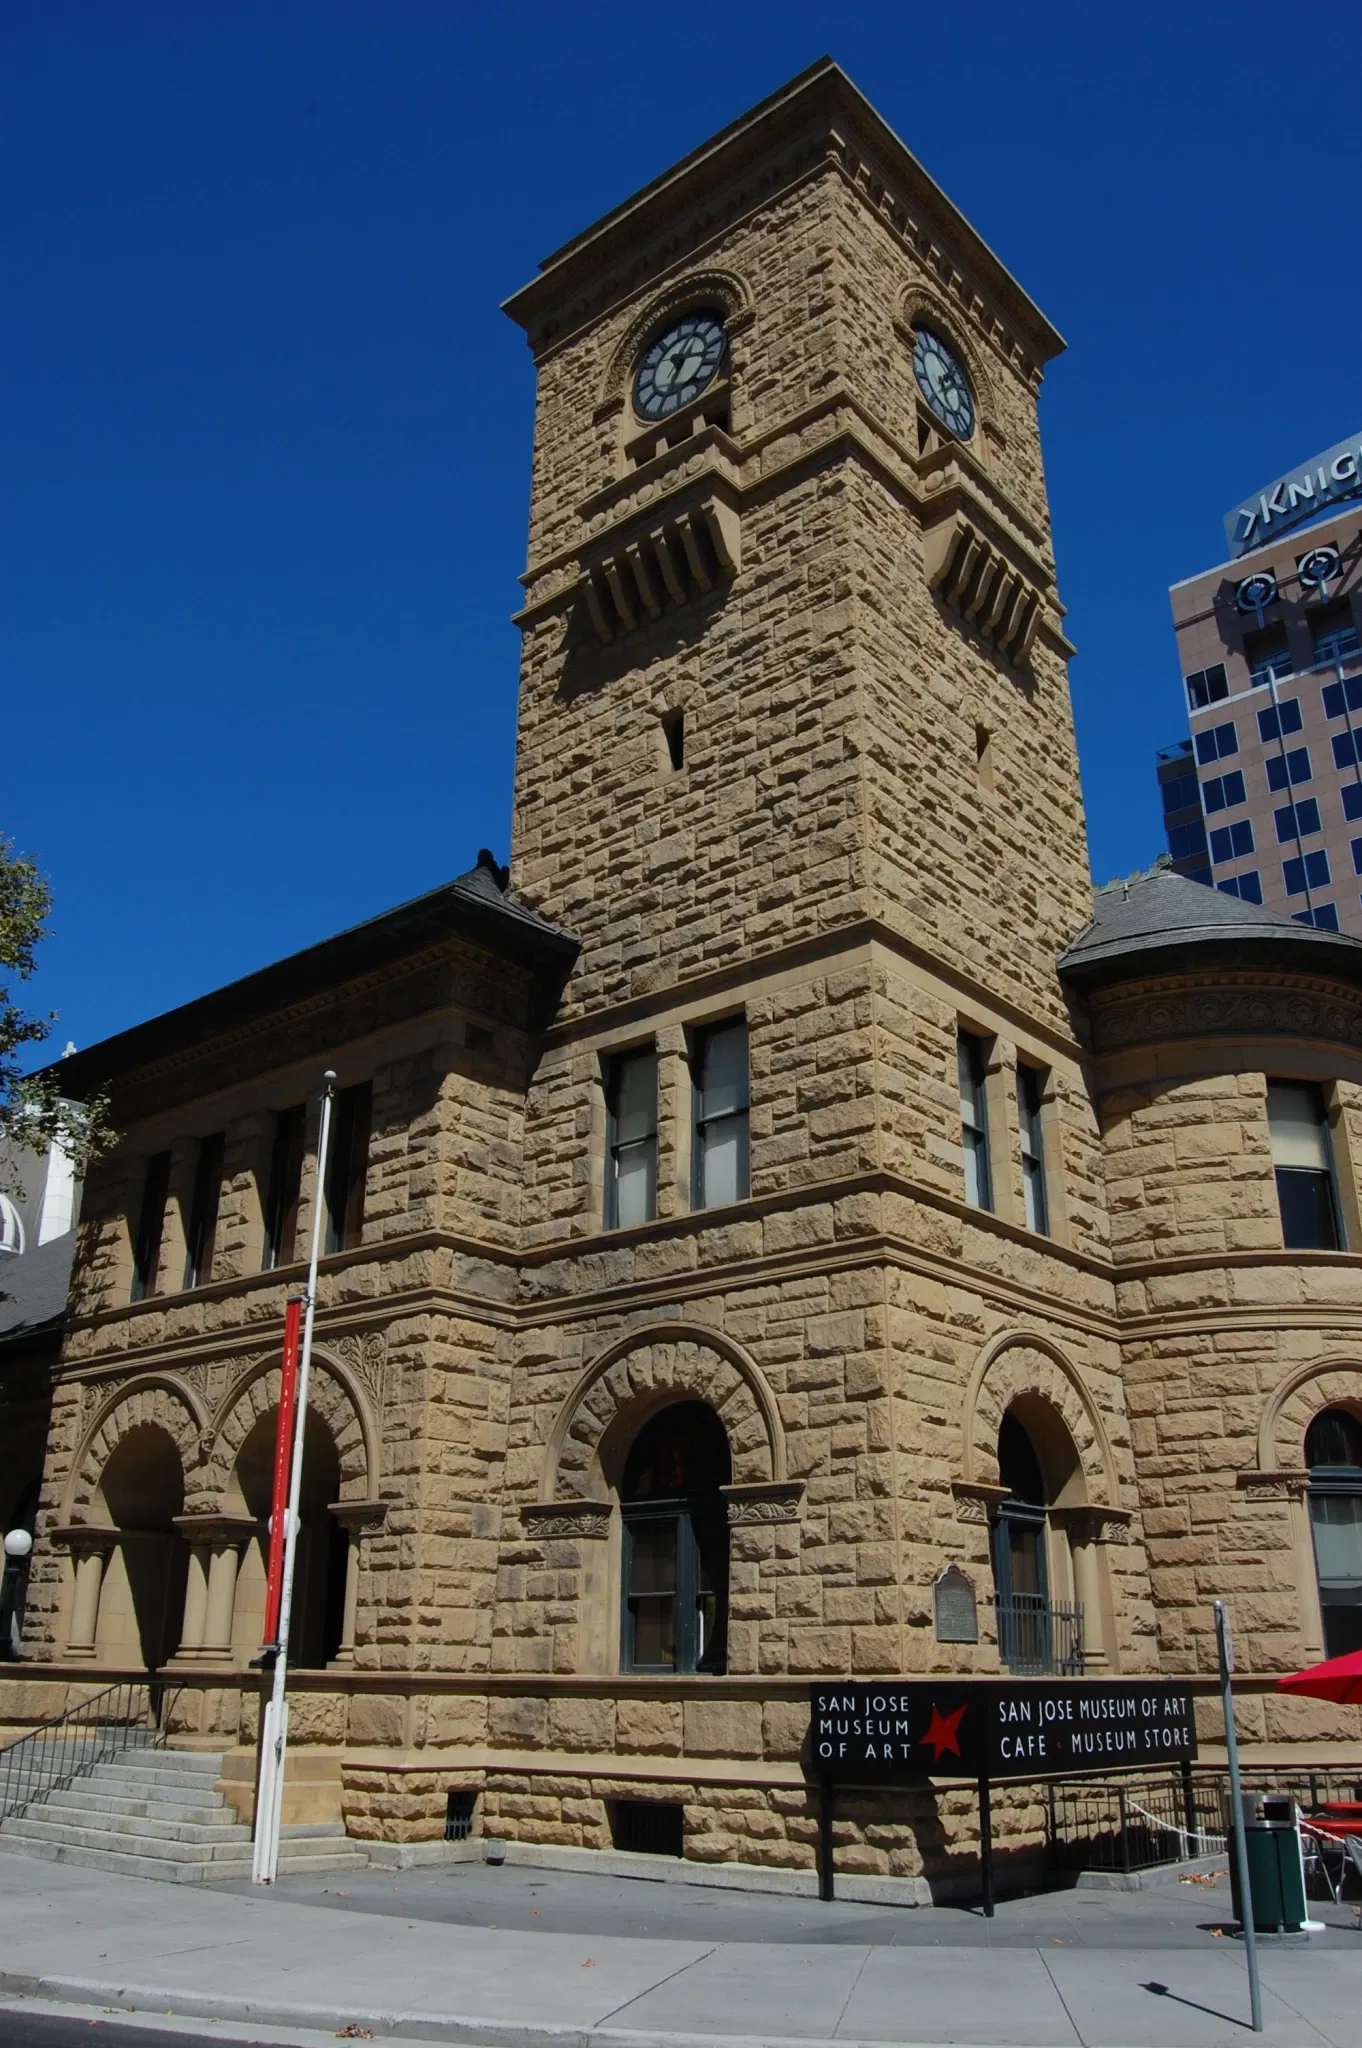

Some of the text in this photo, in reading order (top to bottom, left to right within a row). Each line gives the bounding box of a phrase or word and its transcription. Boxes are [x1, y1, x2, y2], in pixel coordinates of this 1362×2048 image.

[1259, 446, 1362, 525] KNIG
[818, 1696, 909, 1717] SAN JOSE
[999, 1697, 1186, 1727] SAN JOSE MUSEUM OF ART
[820, 1719, 908, 1736] MUSEUM
[819, 1742, 911, 1759] OF ART
[1000, 1727, 1190, 1759] CAFE MUSEUM STORE
